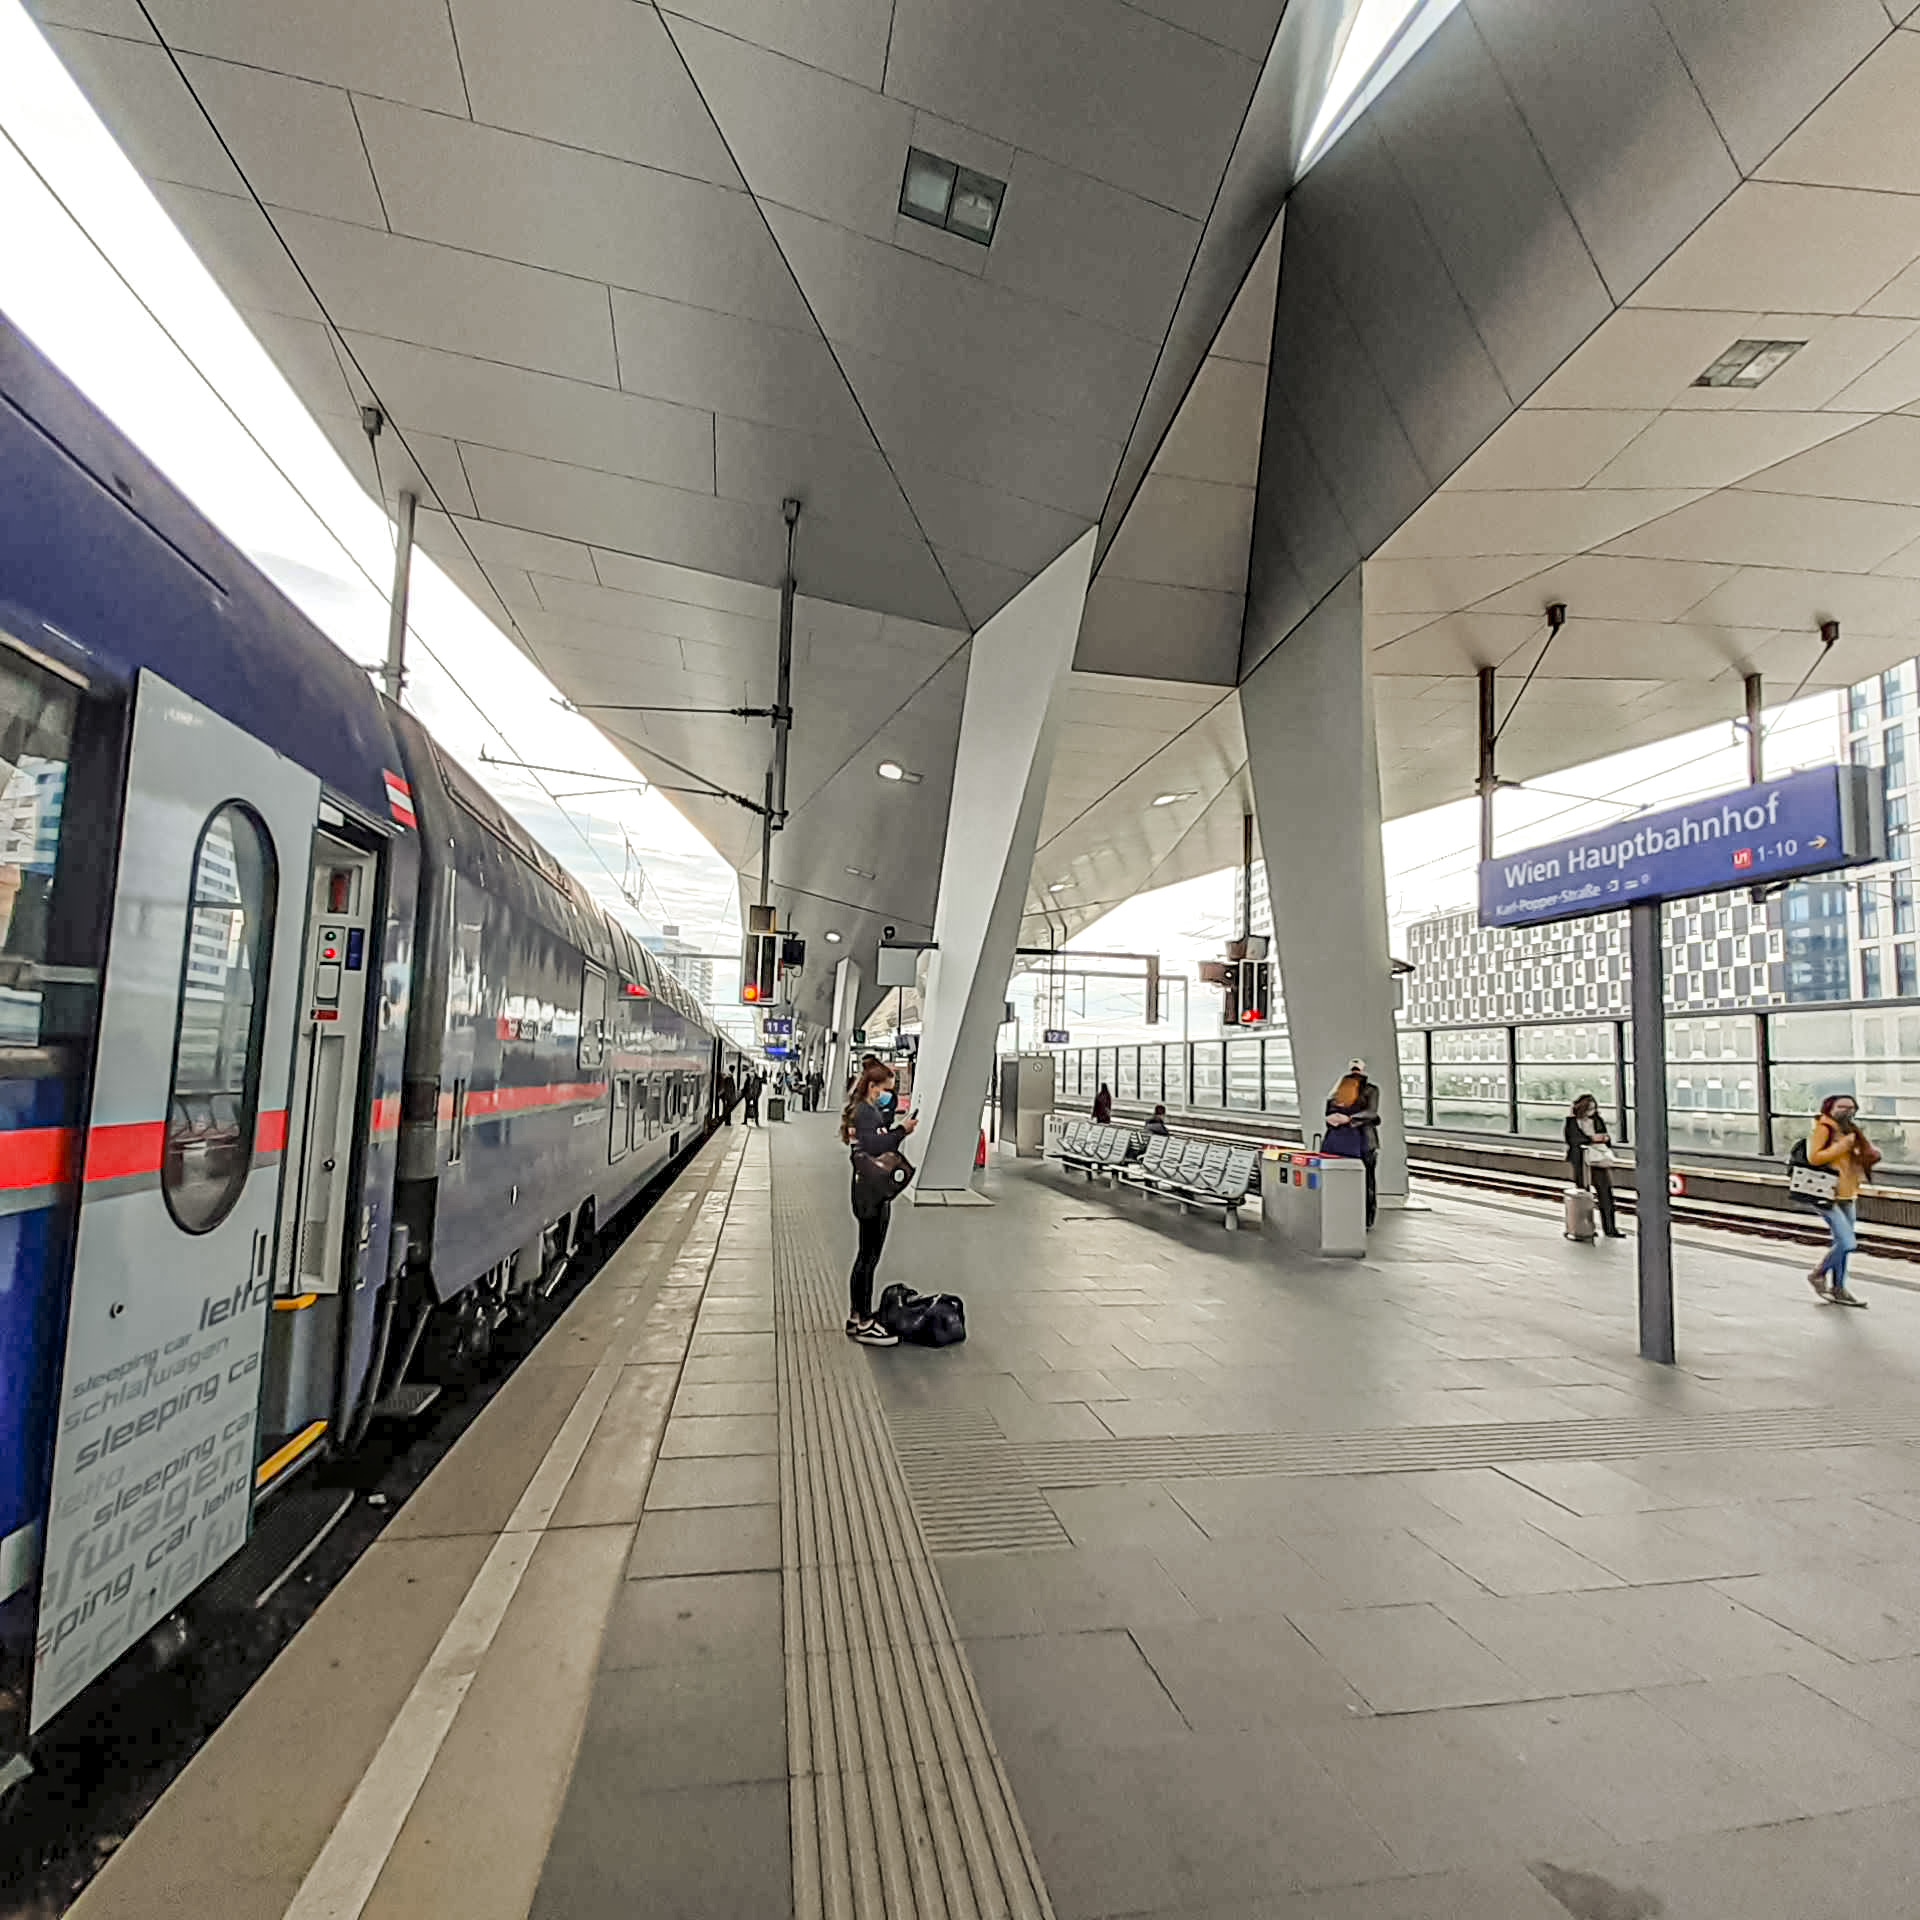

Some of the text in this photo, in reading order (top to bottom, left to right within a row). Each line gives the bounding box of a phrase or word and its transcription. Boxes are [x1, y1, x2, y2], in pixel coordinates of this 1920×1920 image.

[1504, 791, 1780, 889] Wien Hauptbahnhof
[1757, 839, 1798, 862] 1-10
[1496, 883, 1601, 916] Karl-Popper-Straße
[766, 1022, 778, 1033] 11
[63, 1336, 230, 1434] schlafwagen
[72, 1334, 192, 1399] sleeping car
[73, 1373, 220, 1474] sleeping
[92, 1434, 216, 1531] sleeping
[145, 1515, 197, 1571] car
[203, 1474, 247, 1520] letto
